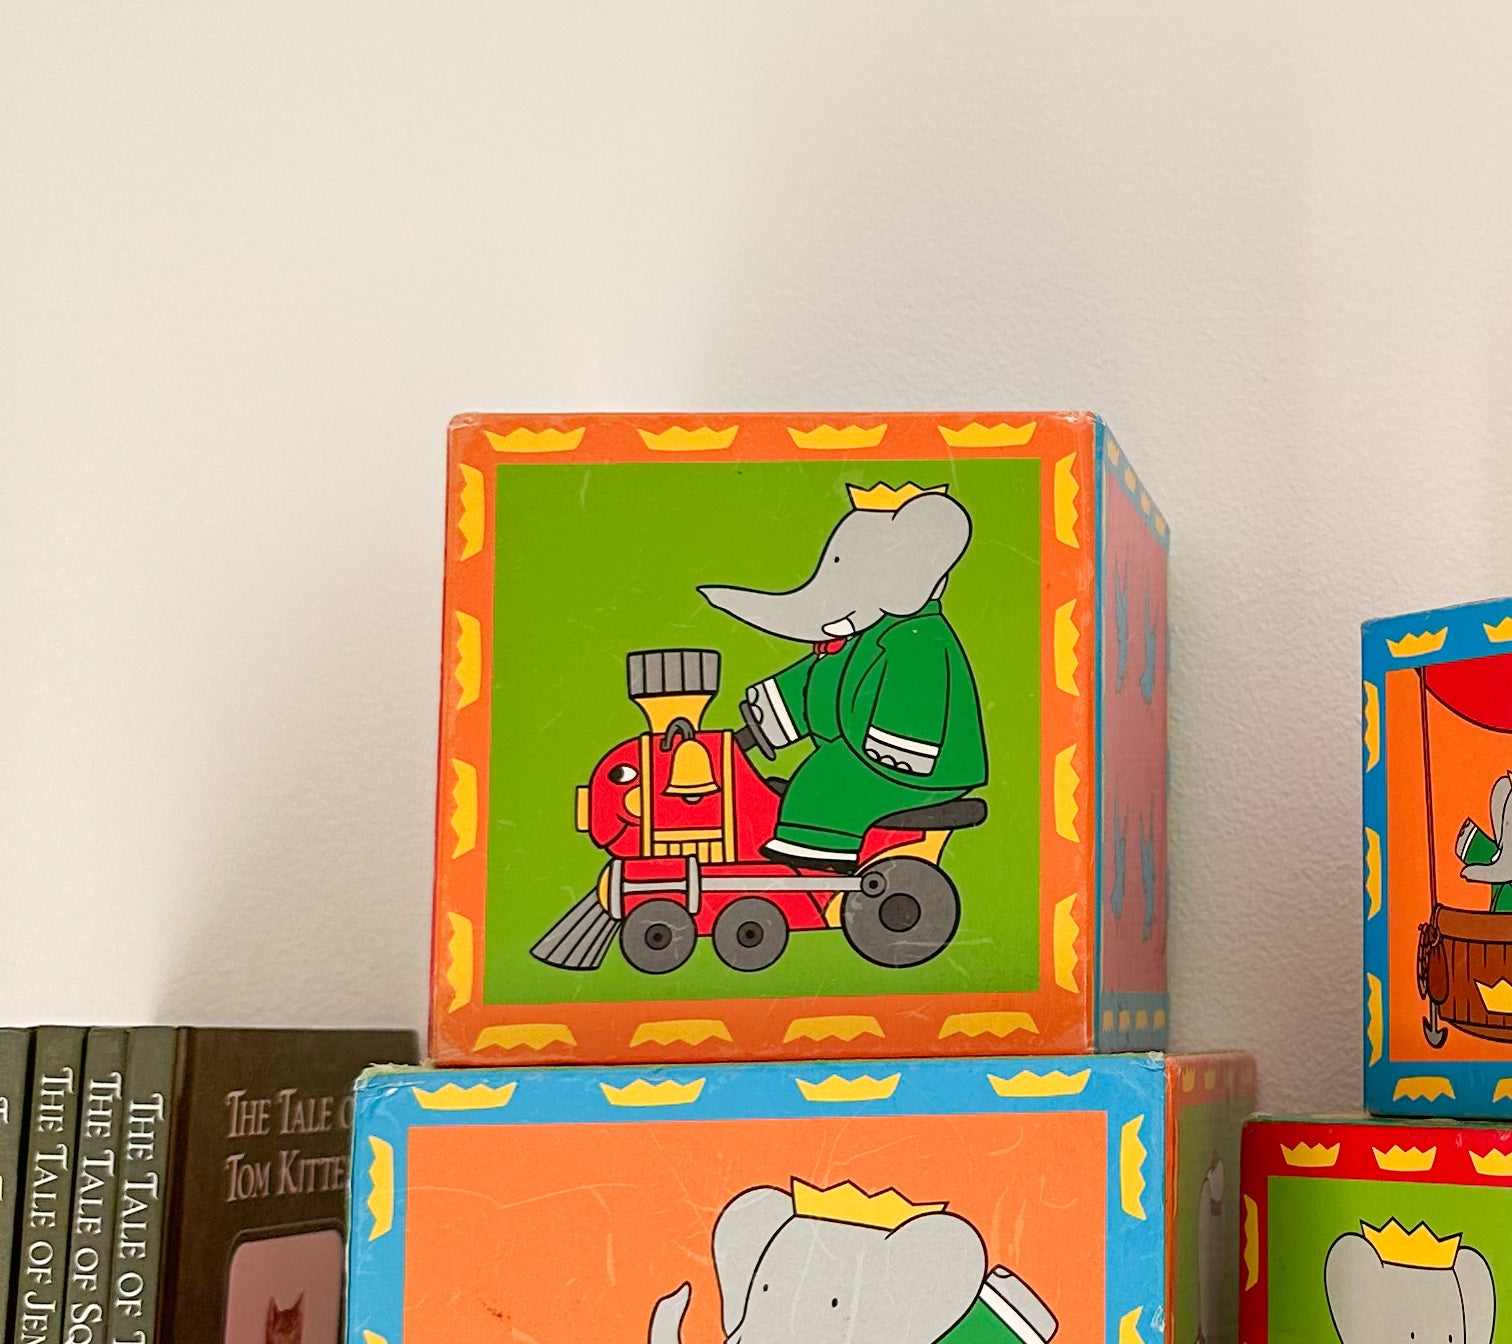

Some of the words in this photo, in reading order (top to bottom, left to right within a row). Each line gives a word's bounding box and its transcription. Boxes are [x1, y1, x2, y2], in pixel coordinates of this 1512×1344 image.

[38, 1067, 74, 1133] THE
[86, 1071, 123, 1138] THE
[127, 1092, 164, 1161] THE
[223, 1088, 273, 1138] THE
[275, 1088, 334, 1135] TALE
[339, 1096, 355, 1129] O
[30, 1143, 68, 1228] TALE
[76, 1149, 115, 1234] TALE
[223, 1152, 272, 1203] TOM
[276, 1149, 348, 1195] KITTE
[119, 1171, 158, 1259] TALE
[27, 1241, 54, 1285] OF
[73, 1247, 99, 1292] OF
[115, 1272, 144, 1318] OF
